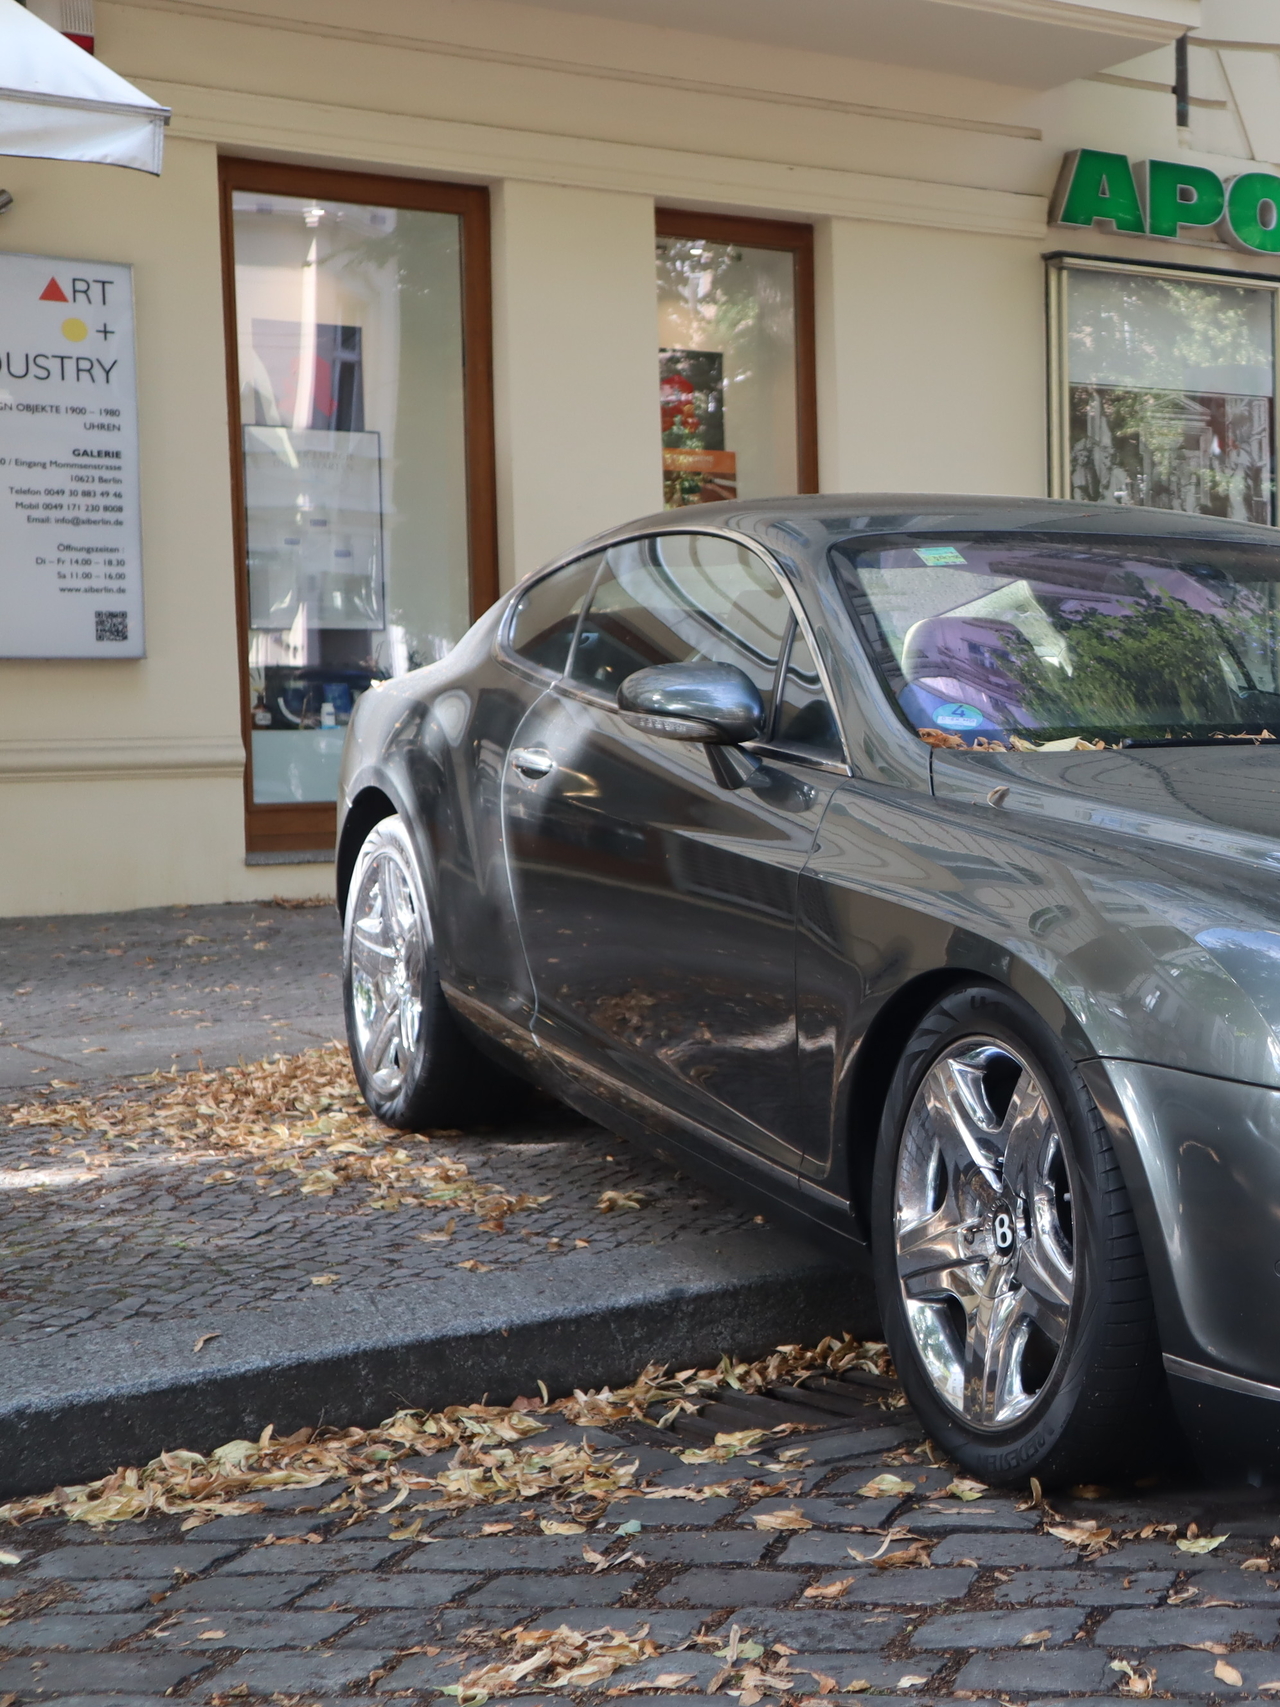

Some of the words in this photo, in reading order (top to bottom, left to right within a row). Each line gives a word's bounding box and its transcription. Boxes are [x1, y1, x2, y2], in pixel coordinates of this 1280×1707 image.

[0, 352, 118, 384] USTRY
[16, 403, 61, 415] OBJEKTE
[65, 406, 87, 415] 1900
[99, 408, 121, 417] 1980
[83, 422, 121, 432] UHREN
[73, 448, 122, 459] GALERIE
[15, 458, 47, 469] Eingang
[49, 460, 122, 471] Mommsenstrasse
[70, 474, 95, 484] 10623
[98, 476, 123, 485] Berlin
[8, 486, 41, 496] Telefon
[44, 488, 65, 496] 0049
[68, 489, 78, 497] 30
[81, 489, 96, 498] 883
[99, 490, 110, 498] 49
[112, 491, 123, 499] 46
[15, 501, 39, 510] Mobil
[42, 502, 63, 511] 0049
[67, 503, 81, 511] 171
[85, 504, 100, 512] 230
[35, 557, 46, 566] Di
[57, 557, 65, 565] Fr
[70, 558, 92, 566] 14.00
[103, 558, 126, 567] 18.30
[57, 571, 66, 579] Sa
[70, 572, 92, 580] 11.00
[104, 572, 126, 580] 16.00
[58, 585, 126, 594] www.aiberlin.de
[951, 705, 966, 719] 4
